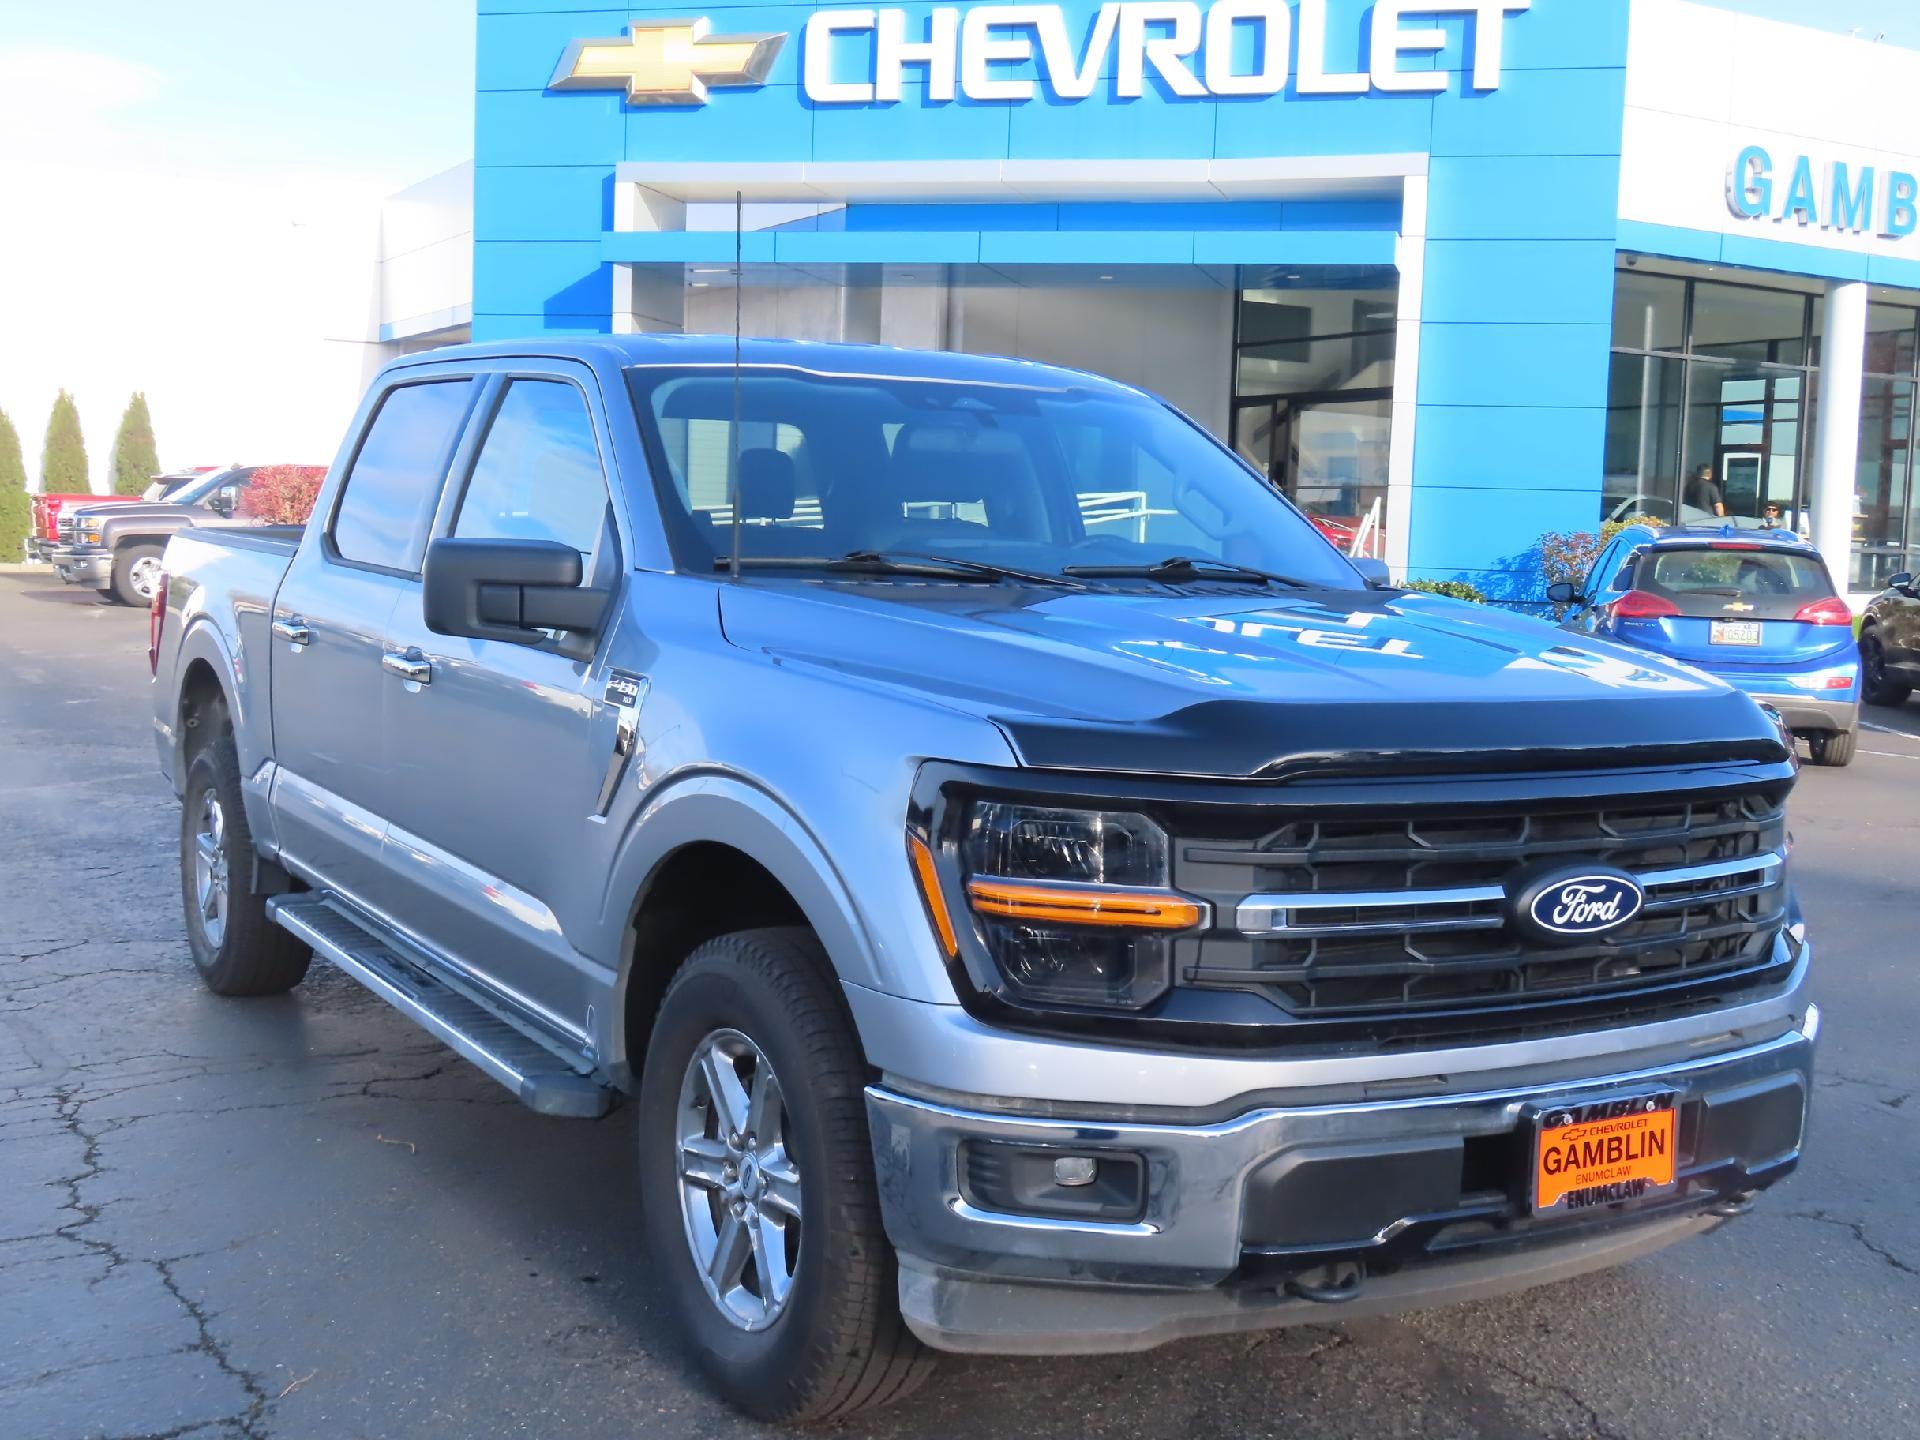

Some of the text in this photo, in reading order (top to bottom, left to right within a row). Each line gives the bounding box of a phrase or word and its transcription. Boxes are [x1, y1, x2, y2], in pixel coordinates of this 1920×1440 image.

[803, 0, 1531, 103] CHEVROLET
[1726, 145, 1919, 239] GAMB
[1553, 884, 1623, 925] Ford
[1589, 1118, 1649, 1136] CHEVROLET
[1543, 1128, 1665, 1176] GAMBLIN
[1566, 1176, 1645, 1210] ENUMCLAW
[1575, 1165, 1632, 1185] ENUMCLAW
